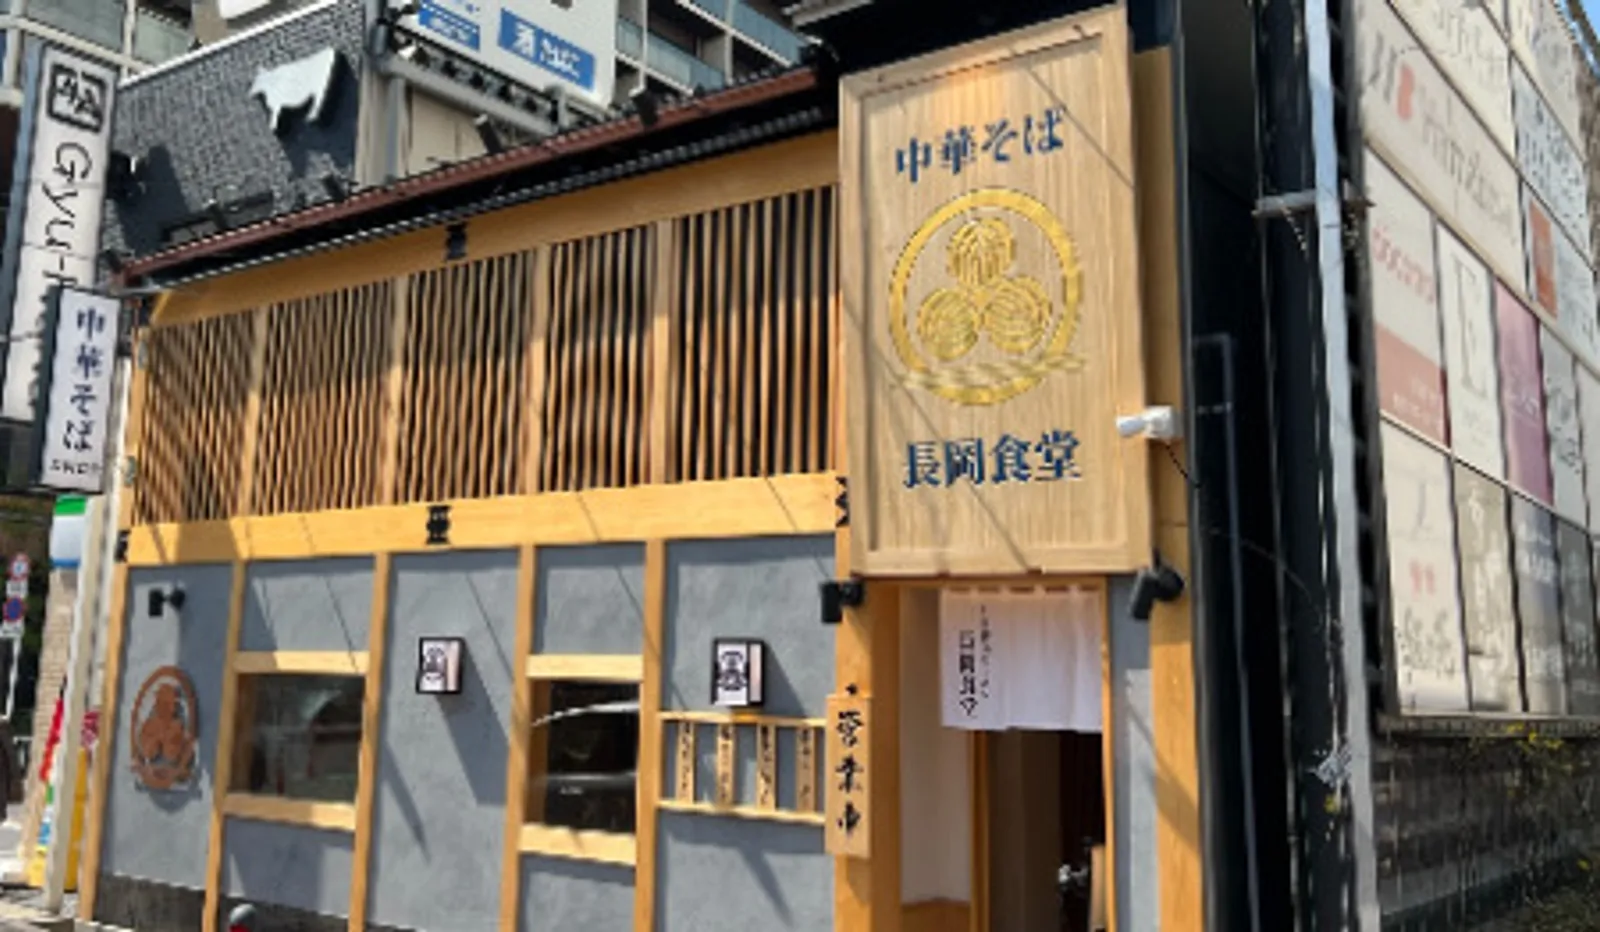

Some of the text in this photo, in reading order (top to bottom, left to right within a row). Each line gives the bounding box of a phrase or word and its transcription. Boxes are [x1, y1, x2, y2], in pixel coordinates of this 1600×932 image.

[896, 106, 1065, 183] 中華そば
[903, 430, 1082, 490] 長岡食堂
